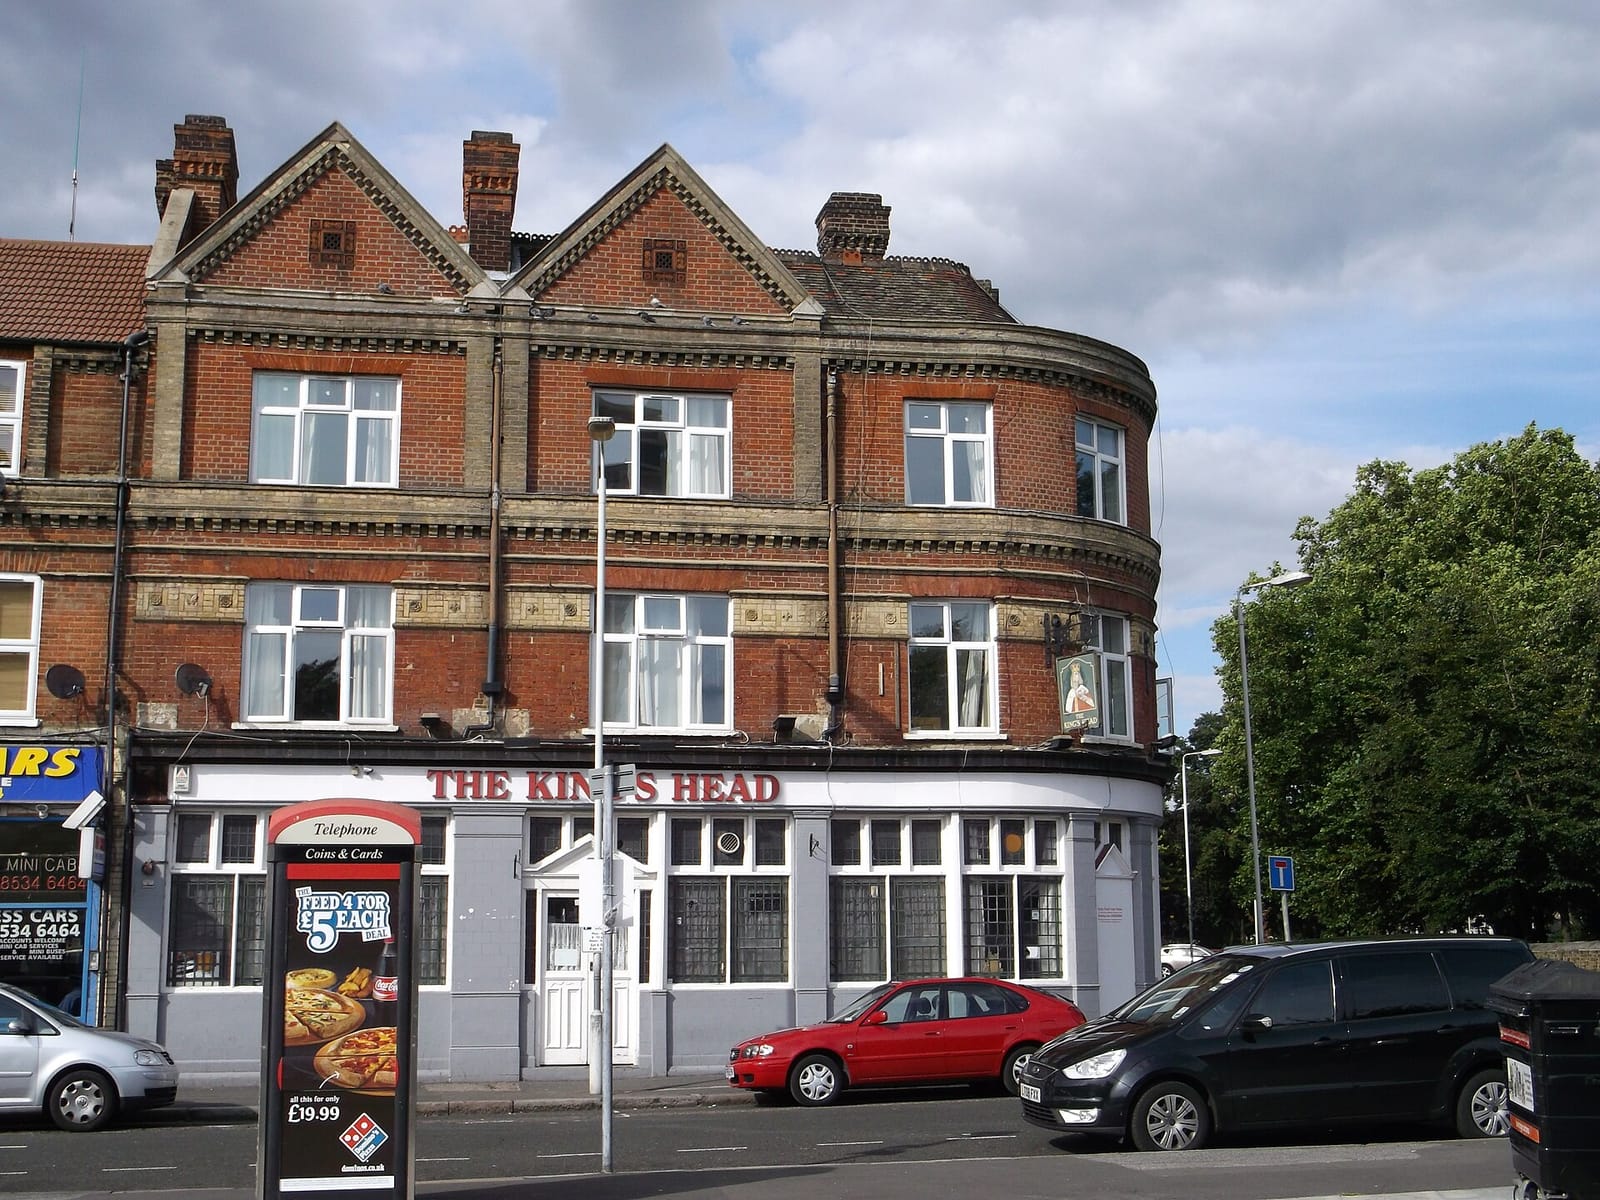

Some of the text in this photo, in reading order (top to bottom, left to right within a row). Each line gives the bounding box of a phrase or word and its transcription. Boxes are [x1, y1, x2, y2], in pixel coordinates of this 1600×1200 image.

[0, 747, 80, 777] RS
[426, 769, 782, 802] THE KINS HEAD
[313, 823, 378, 838] Telephone
[305, 848, 384, 859] Coins & Cards
[7, 857, 78, 872] MINI CAB
[1, 875, 87, 891] 8534 6464
[297, 888, 311, 896] THE
[302, 896, 386, 910] FEED 4 FOR
[0, 909, 79, 923] SS CARS
[36, 923, 81, 937] 6464
[300, 910, 386, 950] £5 EACH
[365, 930, 389, 940] DEAL
[290, 1095, 341, 1104] all this for only
[288, 1103, 340, 1123] £19.99
